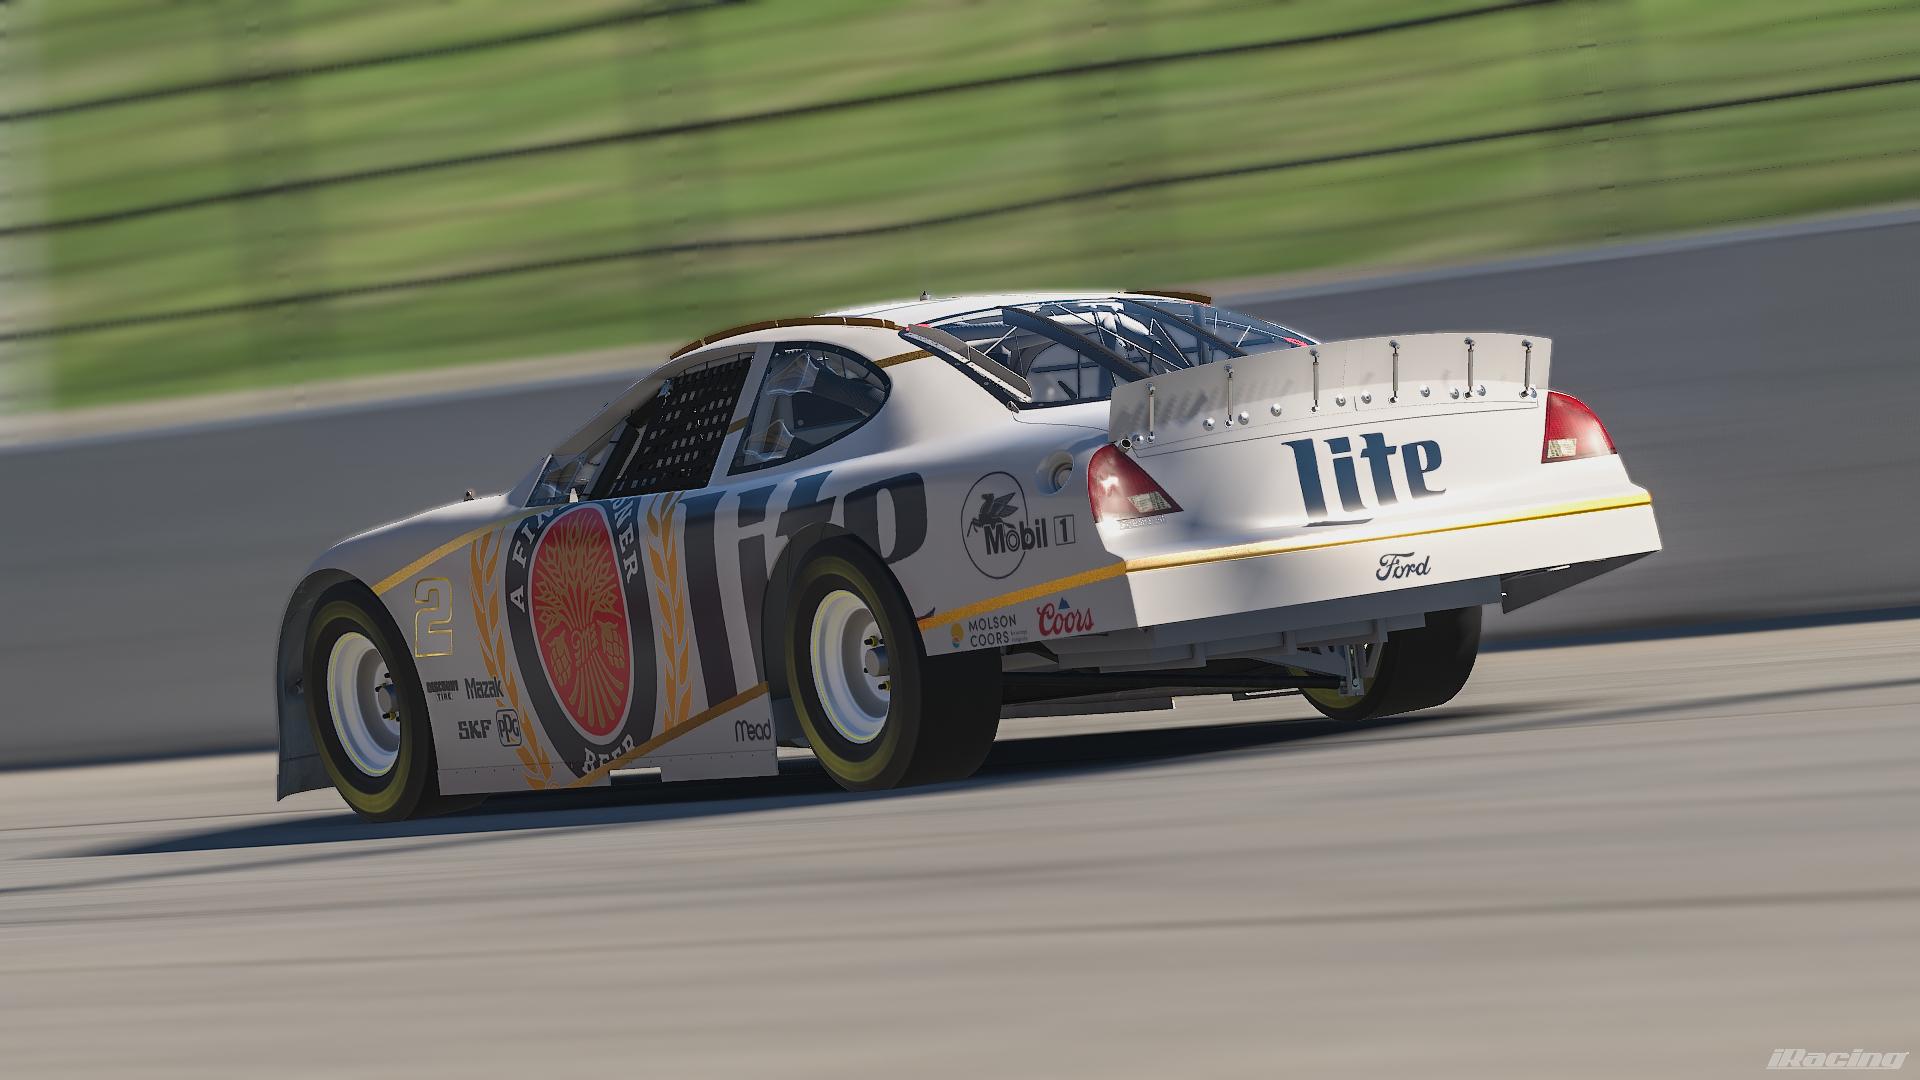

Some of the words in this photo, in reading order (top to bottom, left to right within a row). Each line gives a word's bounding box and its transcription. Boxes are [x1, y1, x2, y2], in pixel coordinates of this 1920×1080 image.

[511, 506, 560, 569] FIN
[983, 517, 1048, 555] Mobil
[1375, 551, 1432, 582] Ford
[510, 584, 527, 613] A
[414, 576, 454, 658] 2
[968, 613, 1017, 633] MOLSON
[1036, 602, 1095, 636] Coors
[970, 631, 1010, 647] COORS
[464, 677, 504, 700] Mazak
[457, 719, 491, 740] SKF
[497, 713, 520, 743] PPG
